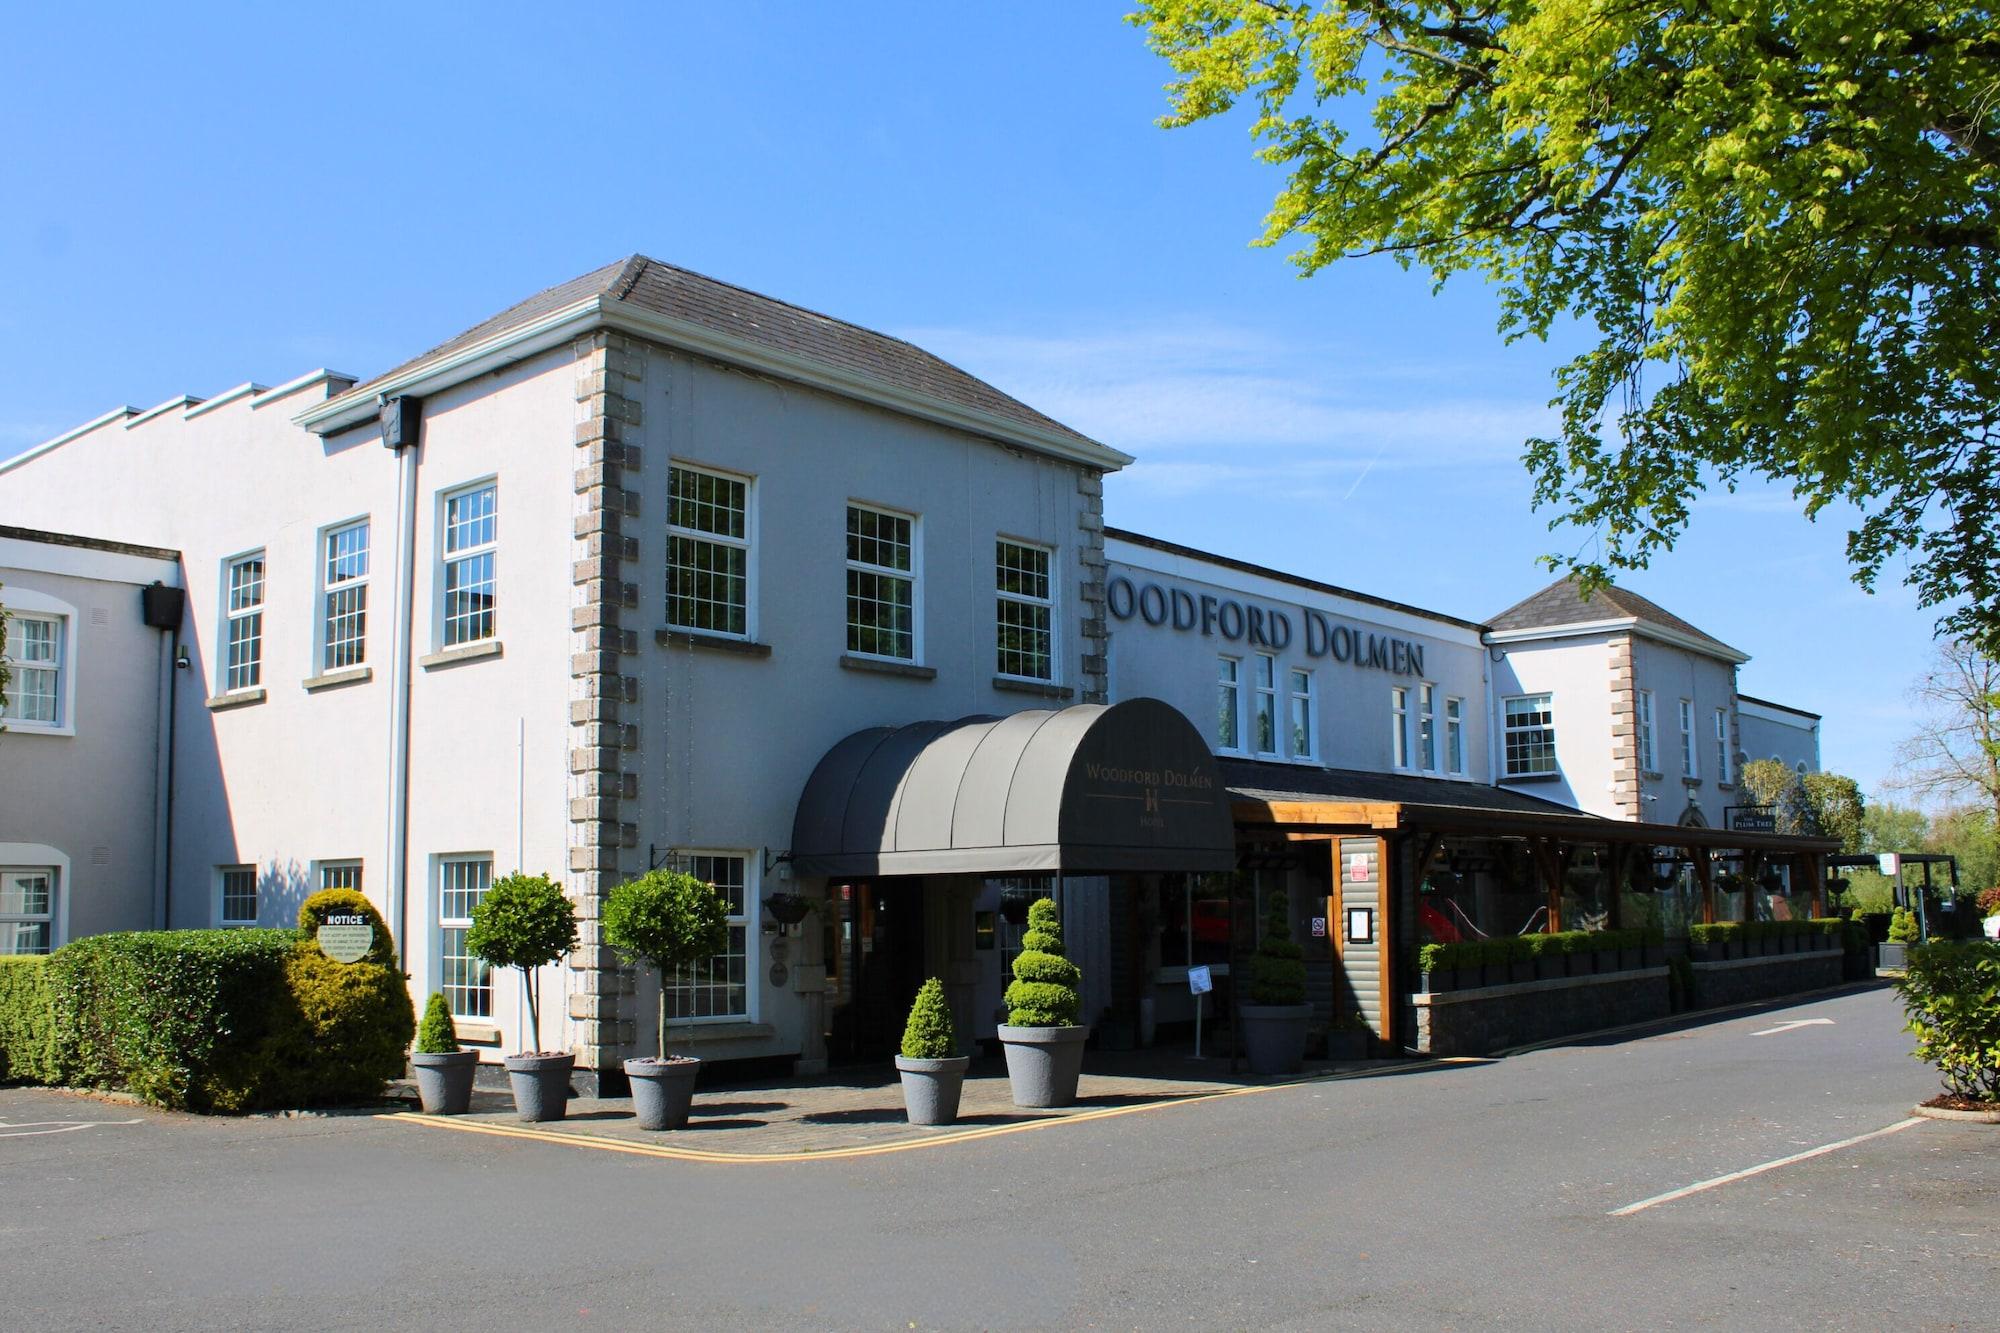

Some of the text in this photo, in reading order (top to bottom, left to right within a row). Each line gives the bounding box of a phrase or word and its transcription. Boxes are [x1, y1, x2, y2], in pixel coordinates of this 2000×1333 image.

[1107, 576, 1425, 678] OODFORD DOLMEN
[1086, 762, 1160, 786] WOODFORD
[327, 915, 363, 925] NOTICE
